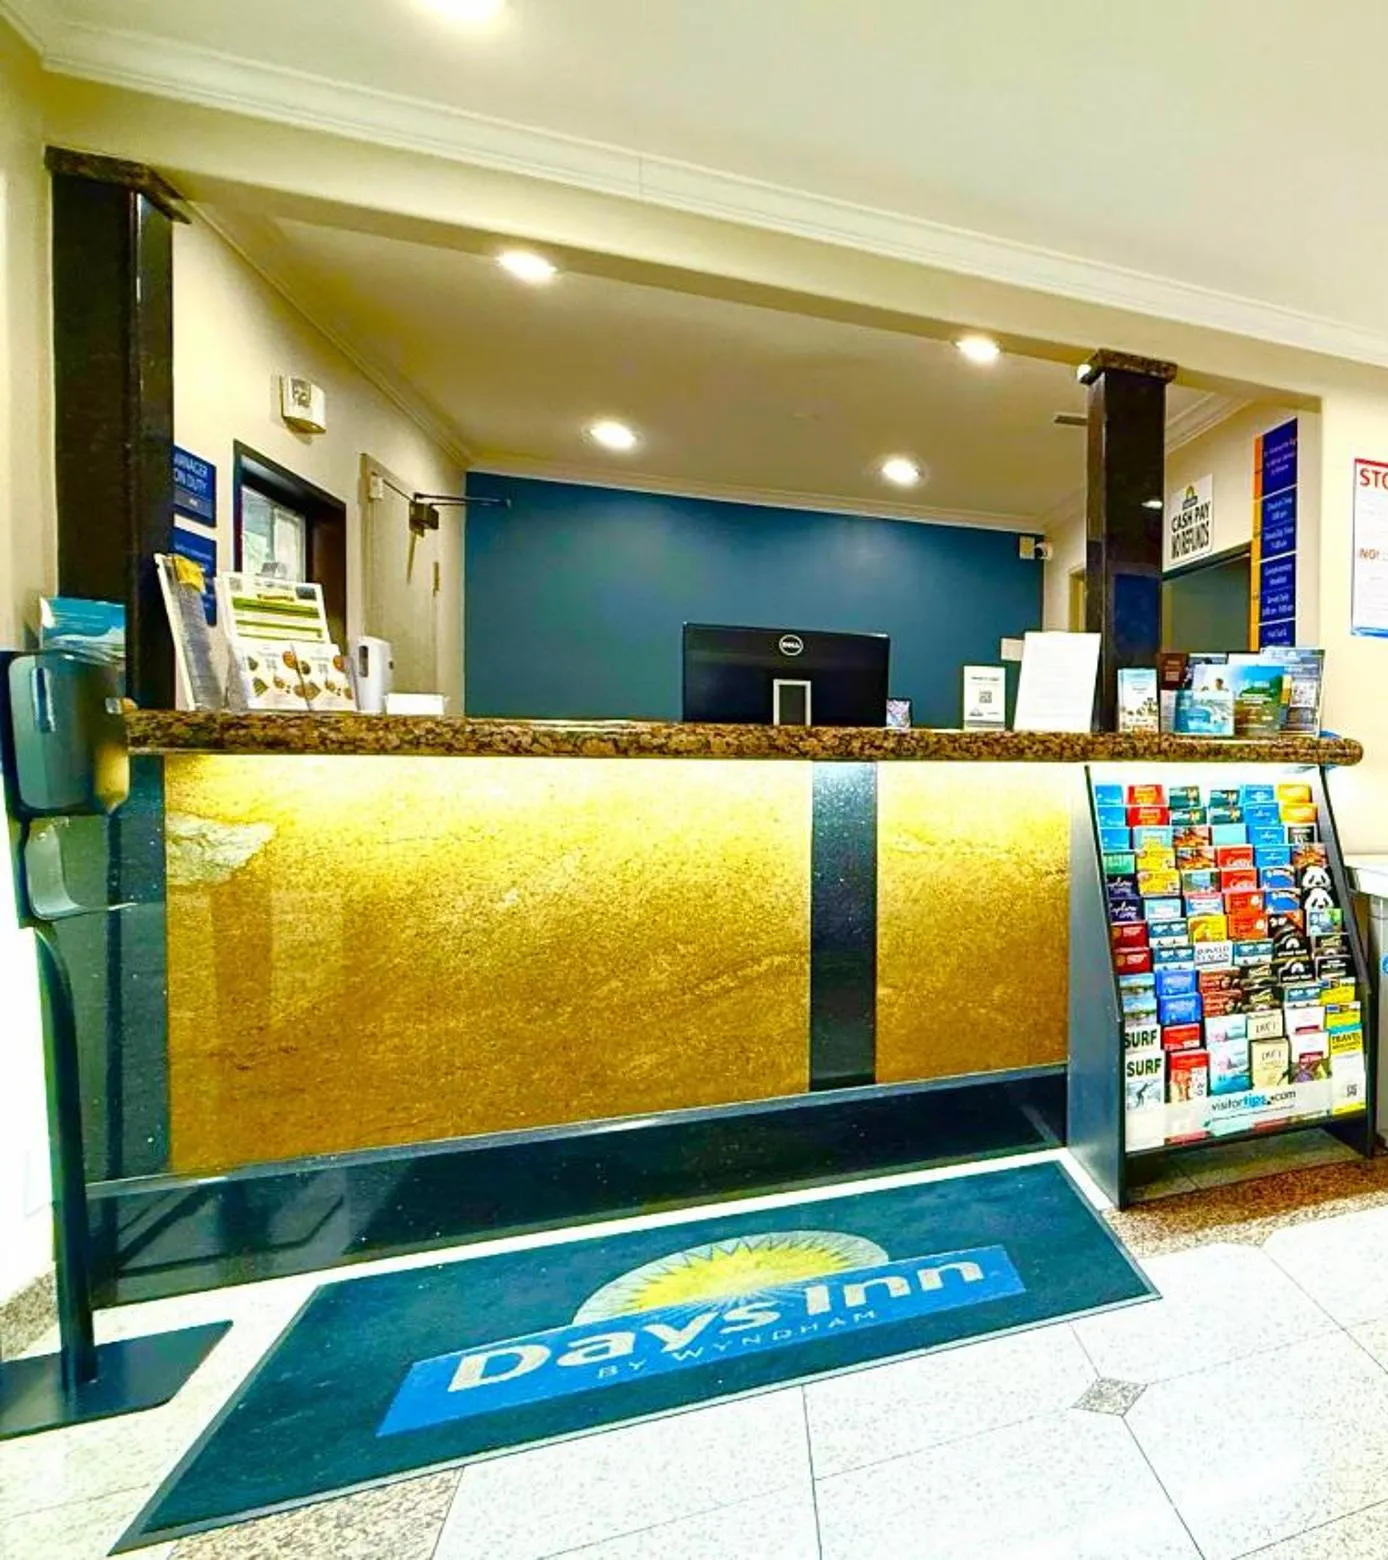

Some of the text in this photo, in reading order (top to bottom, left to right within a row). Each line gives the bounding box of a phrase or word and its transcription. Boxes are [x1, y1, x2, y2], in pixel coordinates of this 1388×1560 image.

[1171, 500, 1211, 533] CASH PAY
[1171, 532, 1180, 559] NO
[1124, 1029, 1158, 1049] SURF
[1126, 1058, 1162, 1078] SURF
[447, 1260, 984, 1393] Days Inn
[598, 1309, 877, 1380] BY WYNDHAM
